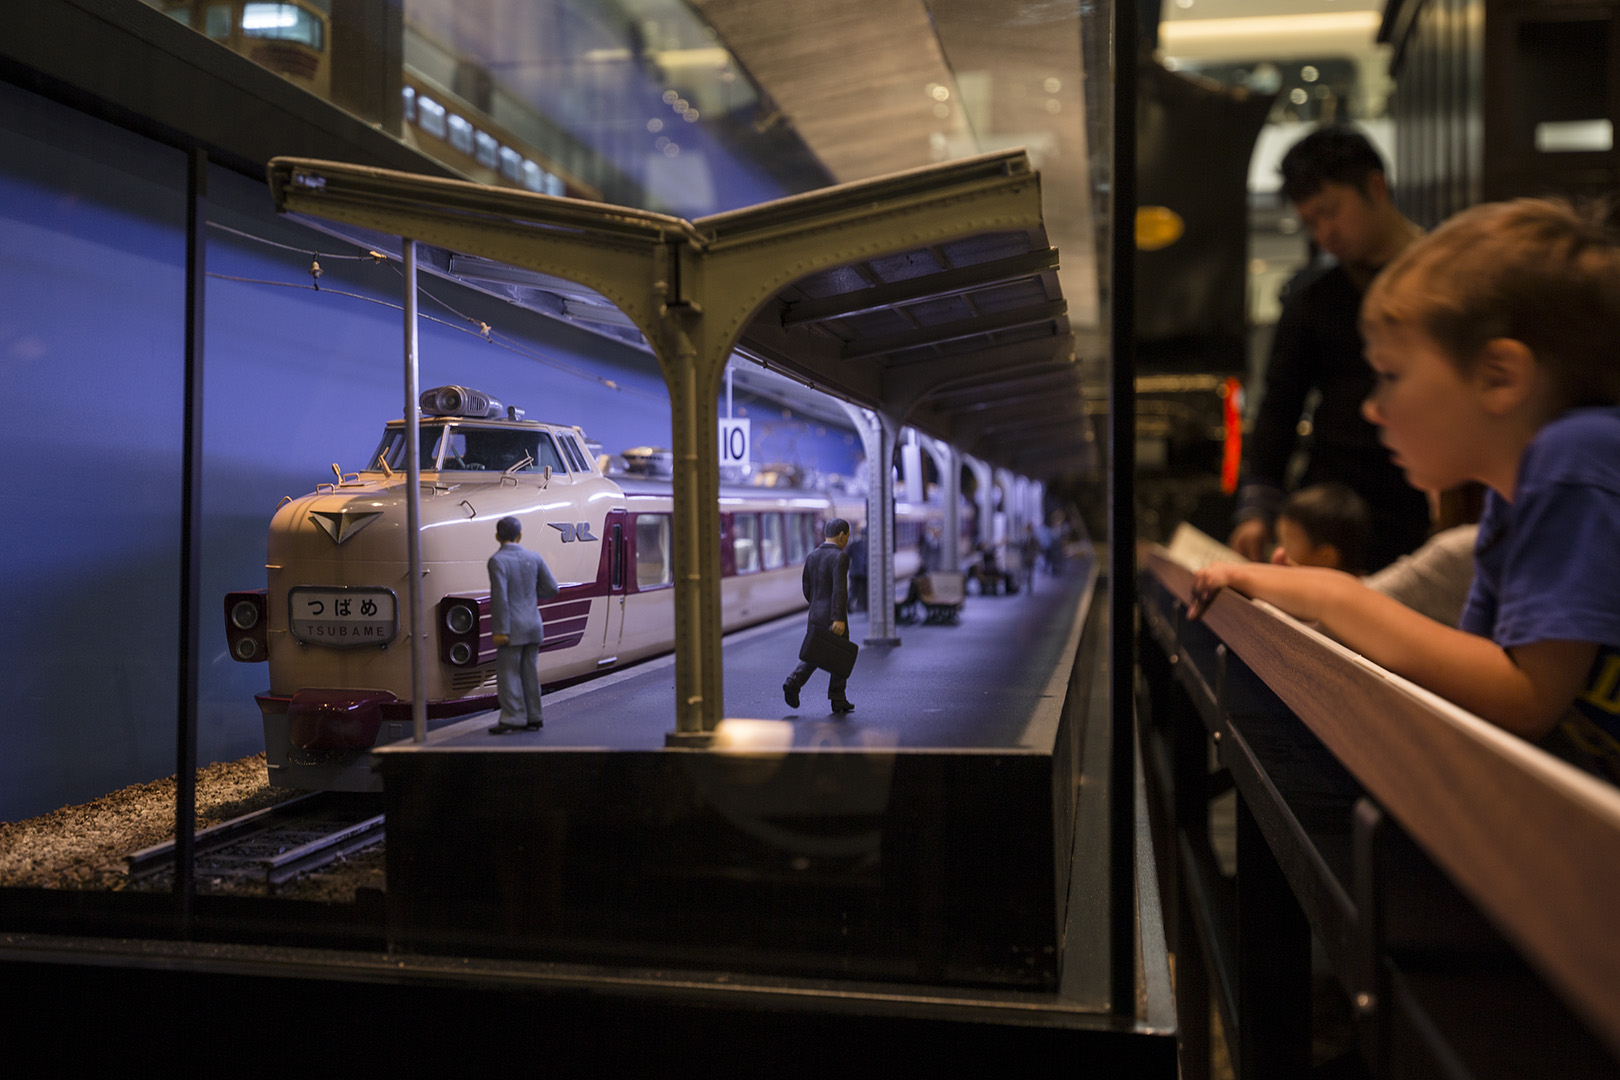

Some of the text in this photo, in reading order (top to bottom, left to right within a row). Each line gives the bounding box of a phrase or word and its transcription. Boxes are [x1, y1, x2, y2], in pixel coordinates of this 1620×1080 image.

[723, 427, 745, 460] 10
[308, 598, 377, 616] つばめ
[307, 625, 385, 637] TSUBAME
